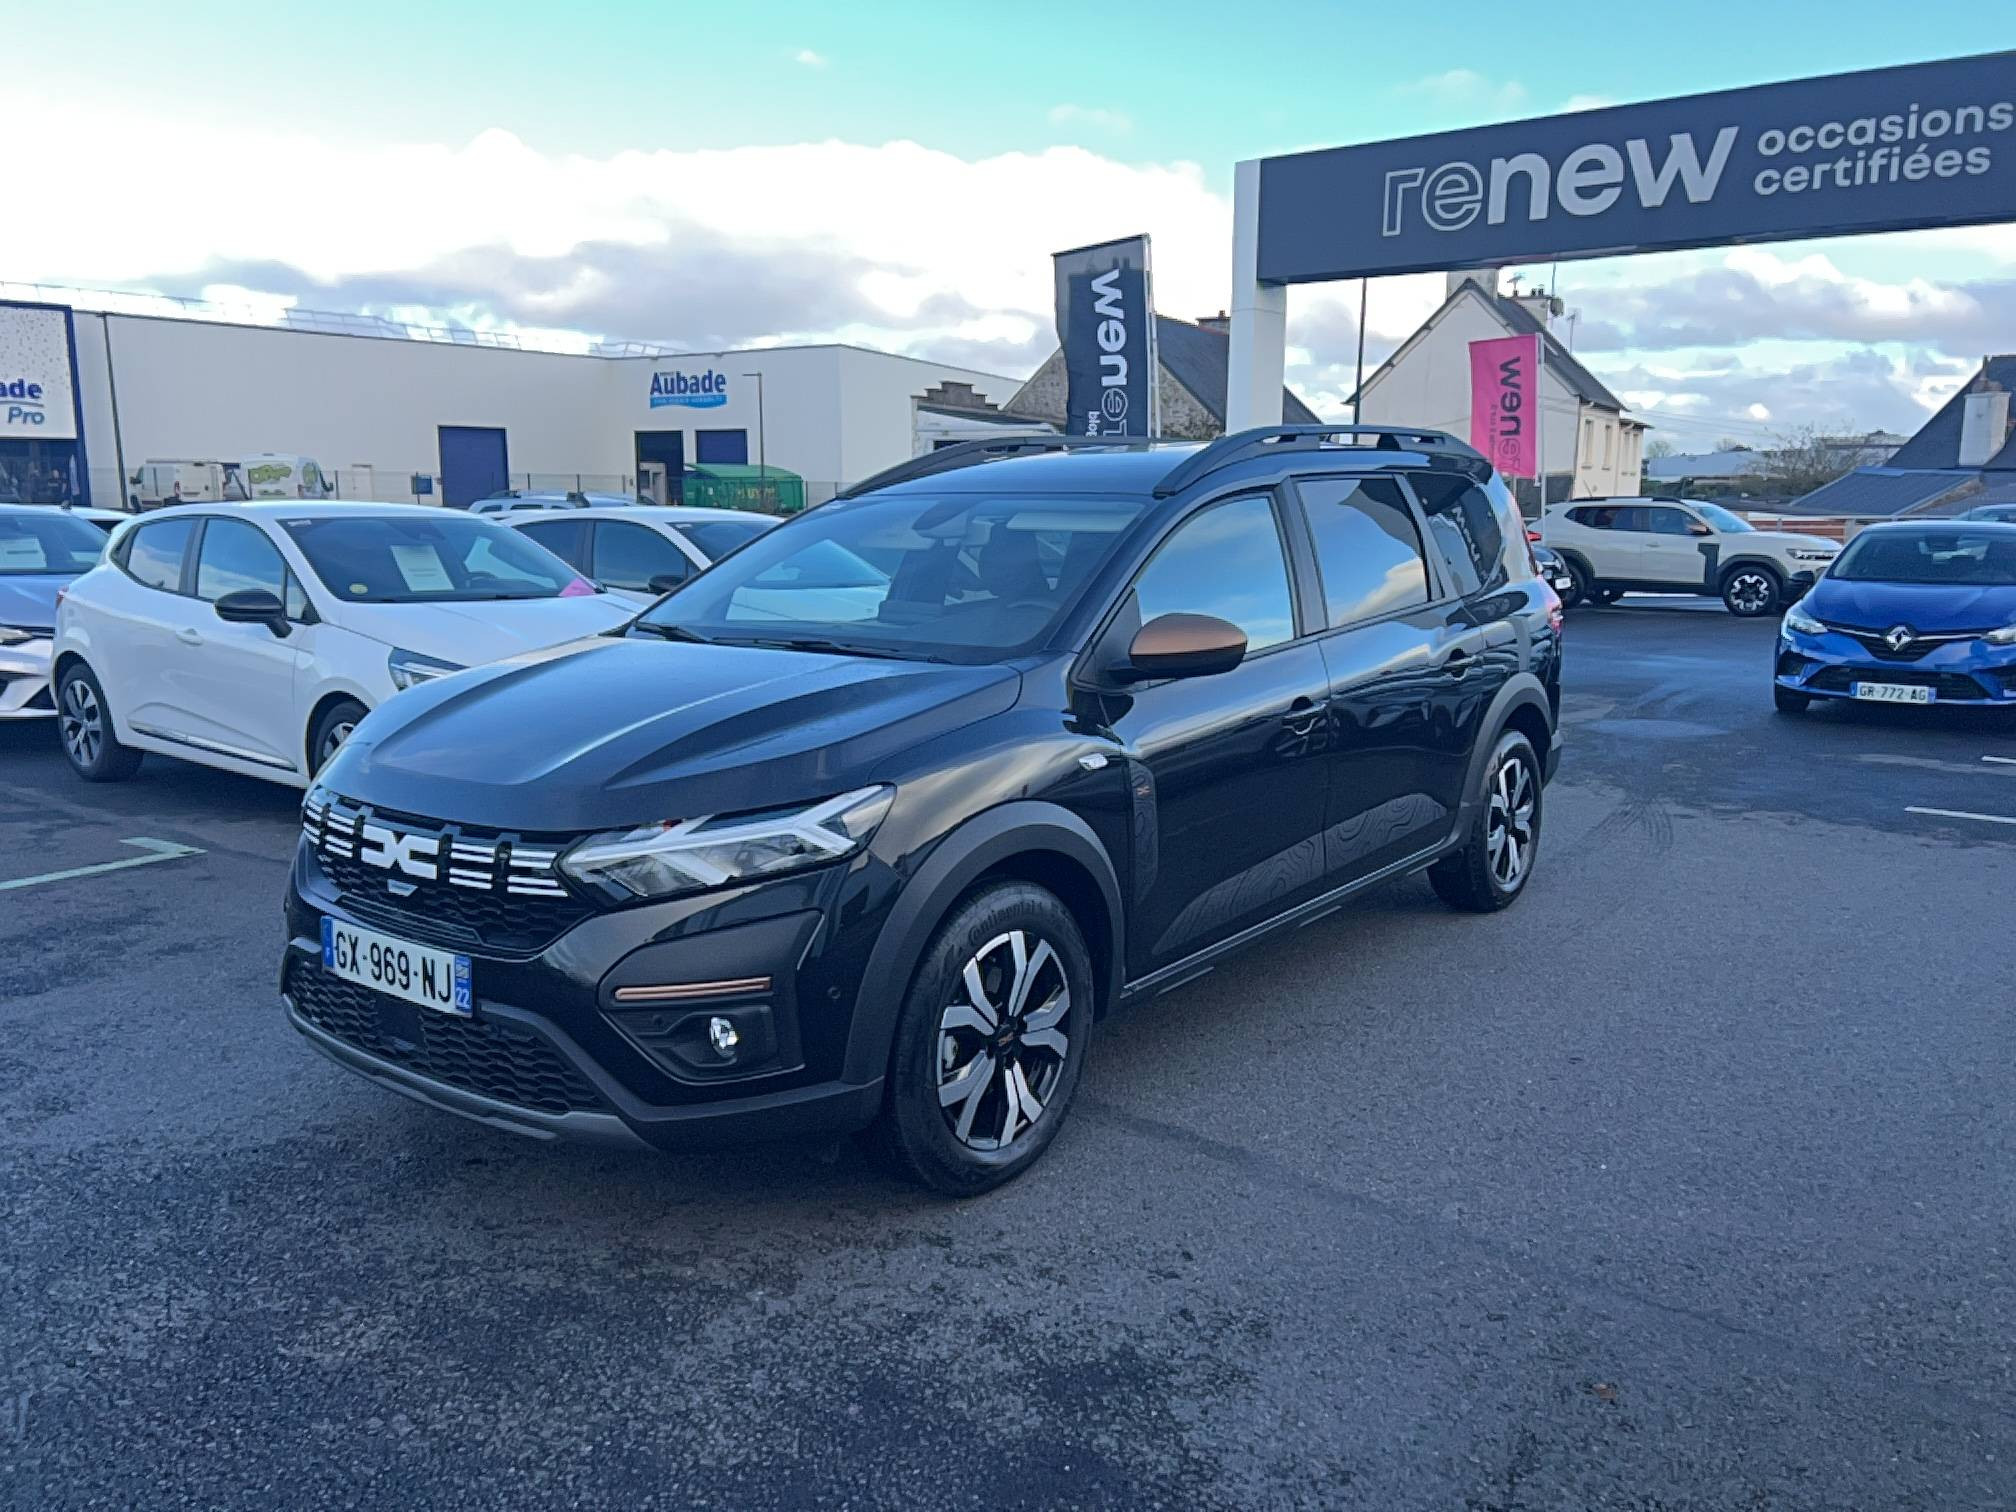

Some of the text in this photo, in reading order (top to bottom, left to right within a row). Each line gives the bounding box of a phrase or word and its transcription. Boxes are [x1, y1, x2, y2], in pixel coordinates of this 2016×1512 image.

[1757, 101, 2014, 157] occasions
[1382, 126, 1739, 237] renew
[1753, 144, 1991, 196] certifiées
[650, 368, 727, 395] Aubade
[8, 406, 45, 425] Pro
[335, 930, 452, 1003] GX-969-NJ
